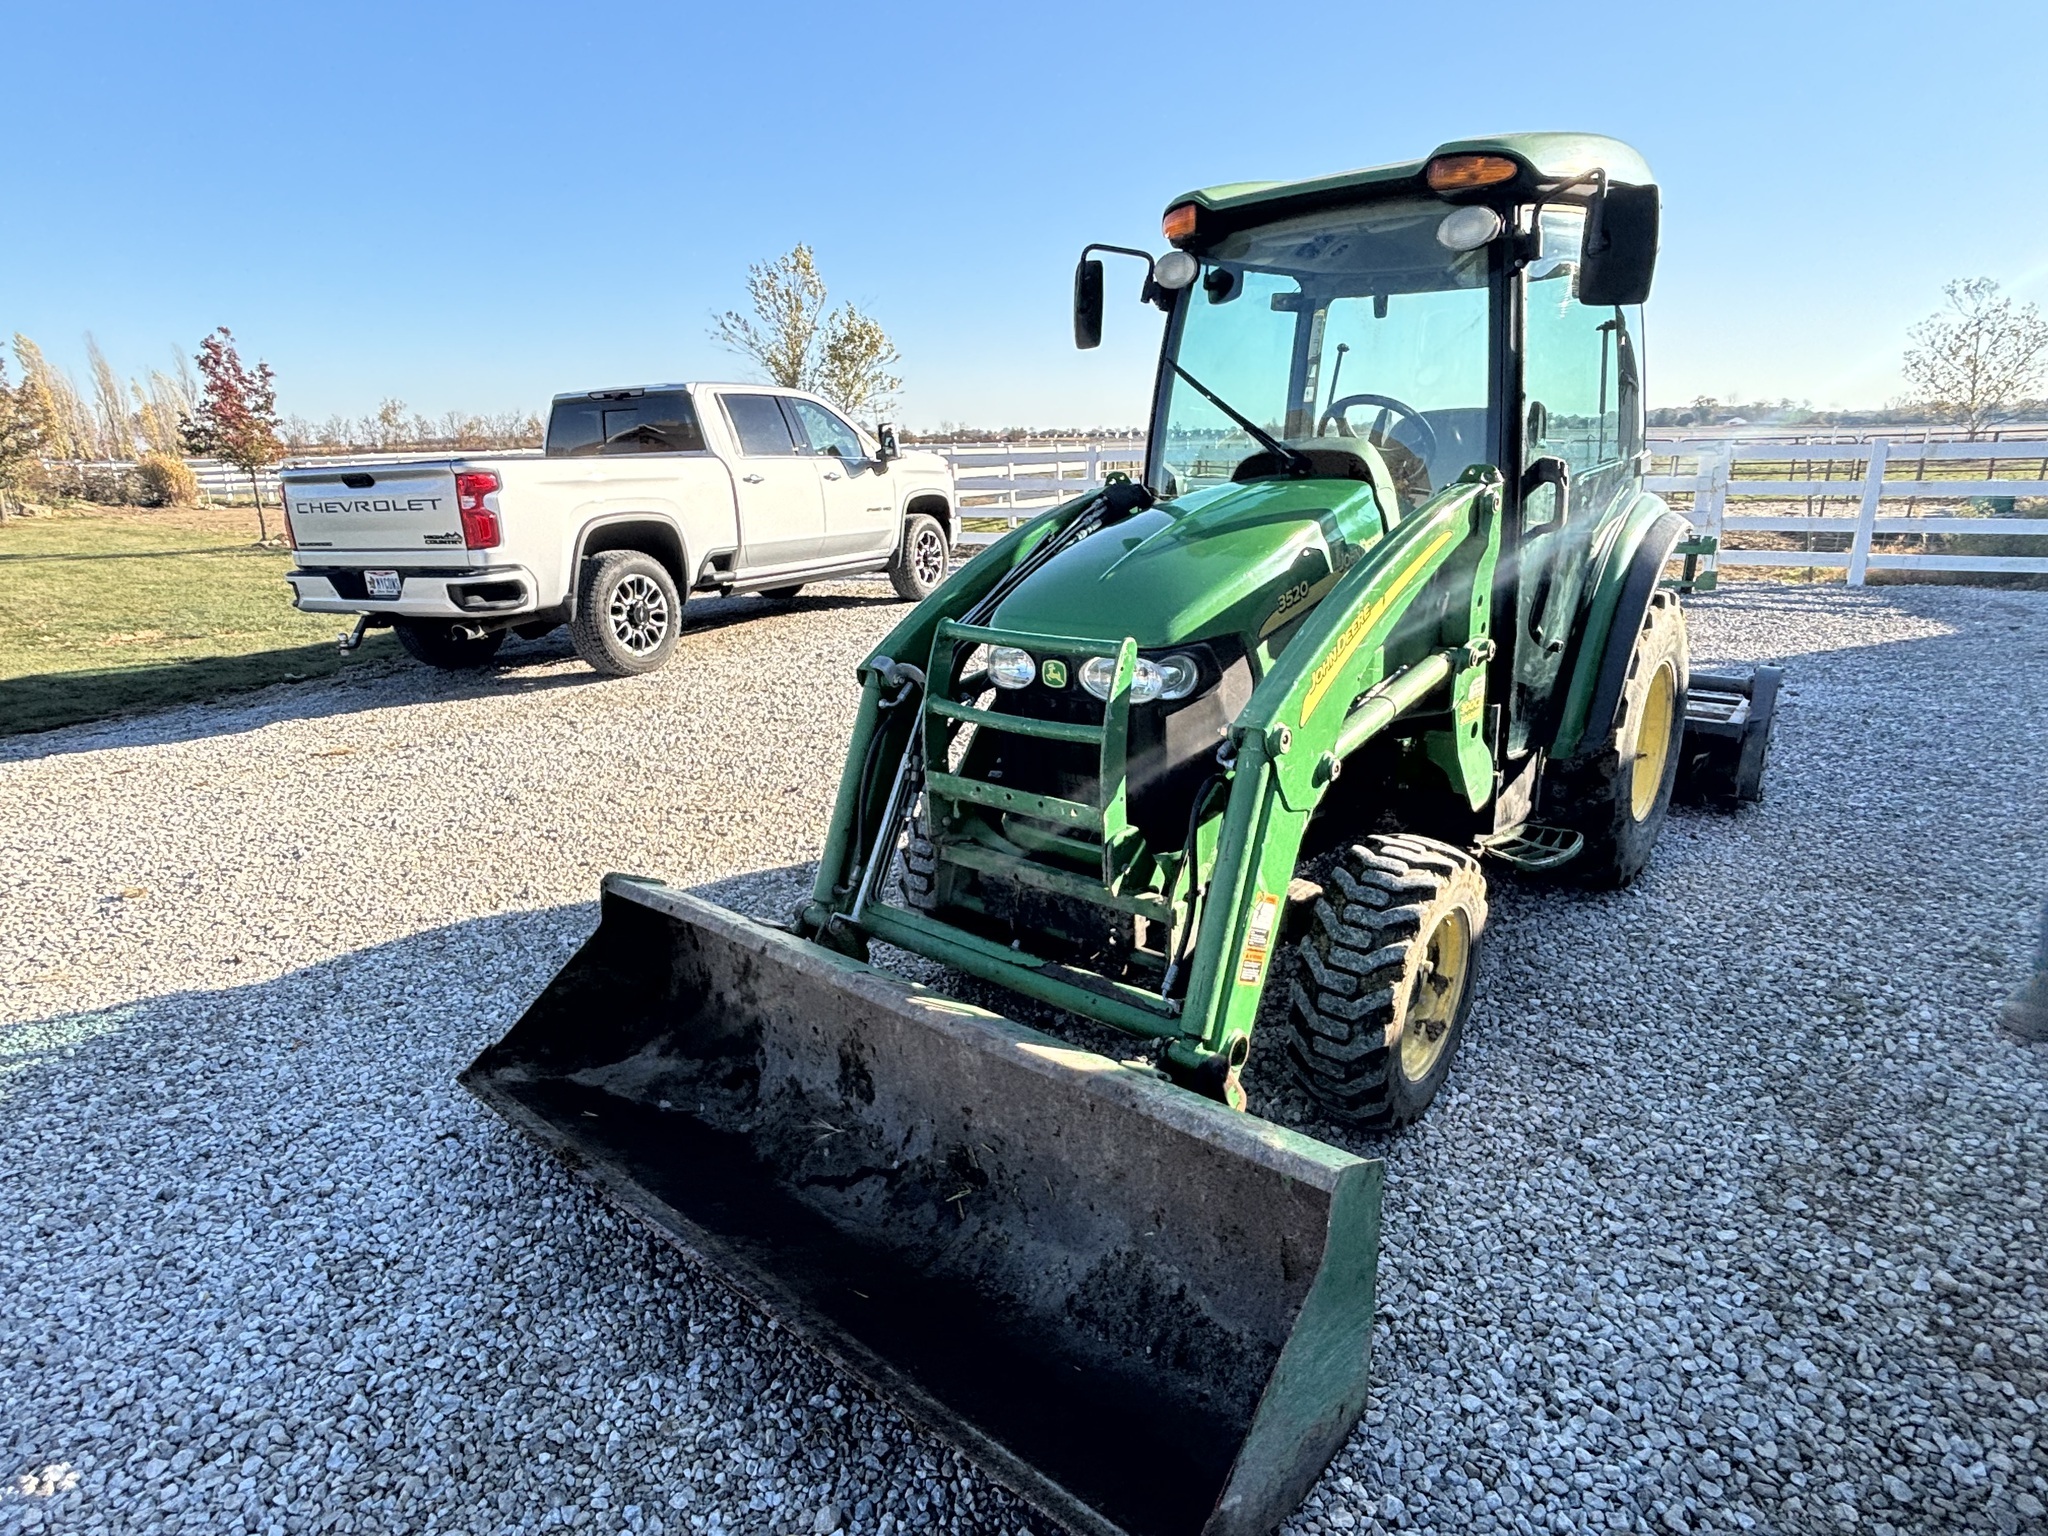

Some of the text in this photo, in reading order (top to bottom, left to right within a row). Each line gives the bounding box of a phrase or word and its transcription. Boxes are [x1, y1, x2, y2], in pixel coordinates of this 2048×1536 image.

[296, 498, 442, 514] CHEVROLET
[1277, 580, 1309, 613] 3520
[1309, 602, 1372, 695] JOHN DEERE
